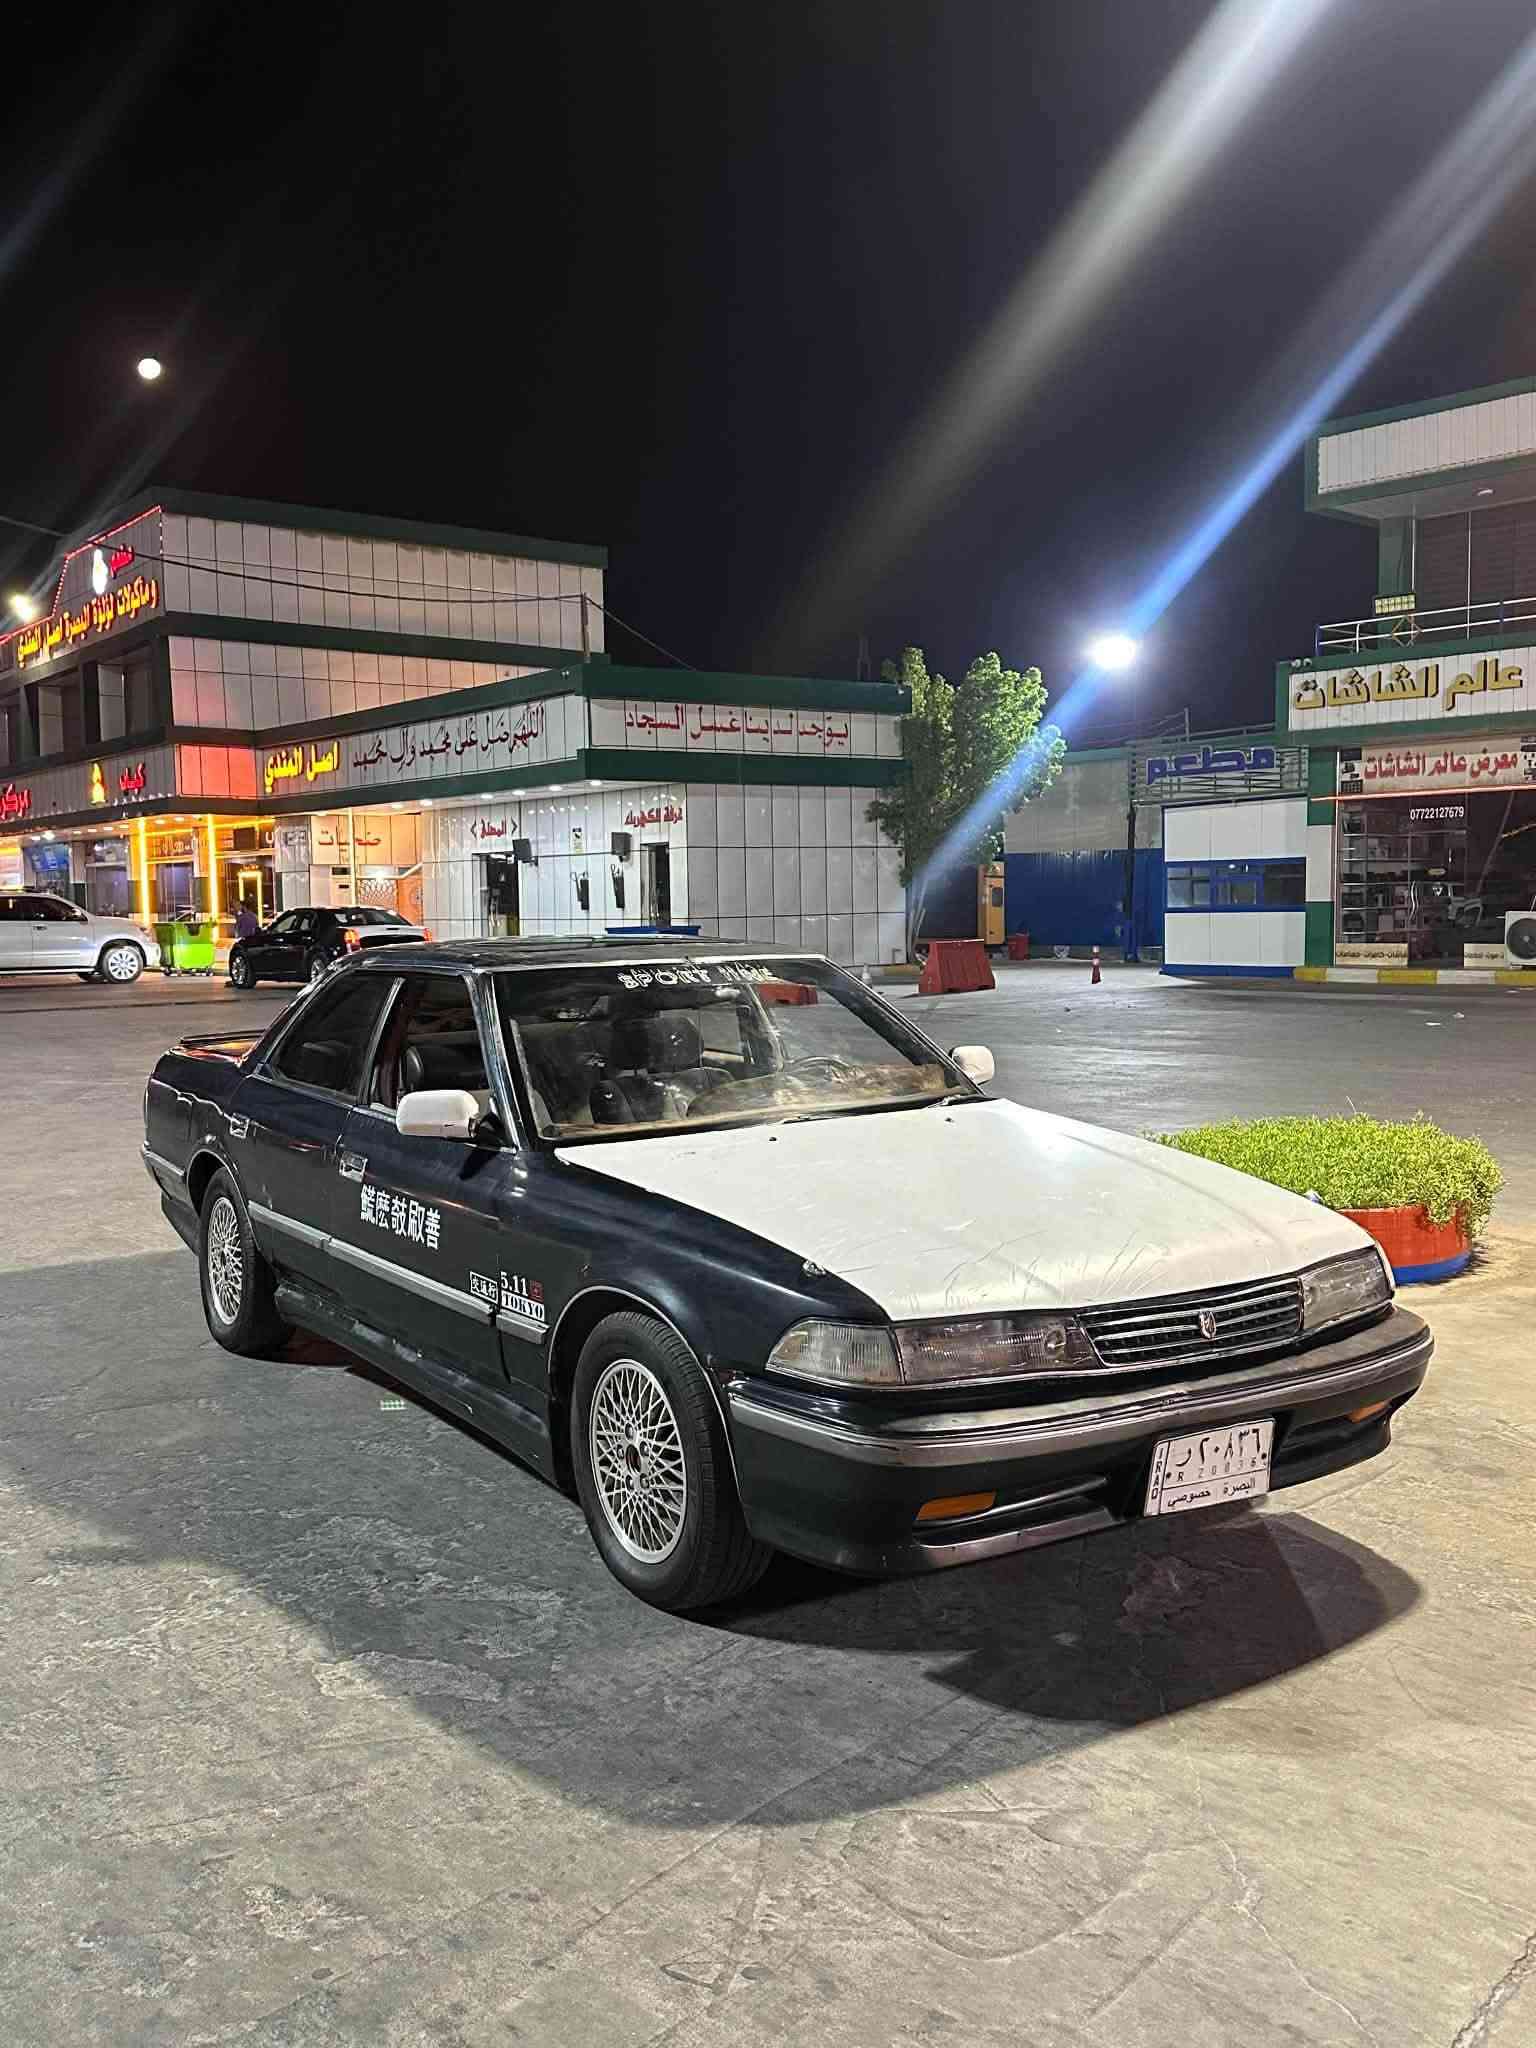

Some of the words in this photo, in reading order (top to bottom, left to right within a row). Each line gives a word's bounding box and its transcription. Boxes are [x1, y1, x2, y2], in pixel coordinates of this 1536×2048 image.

[1295, 663, 1439, 710] الشاشات
[1446, 658, 1523, 711] عالم
[626, 702, 684, 736] السجاد
[690, 705, 741, 741] غسل
[264, 745, 304, 793] المندي
[1145, 744, 1278, 786] مطعم
[1364, 750, 1426, 780] الشاشات
[1427, 750, 1468, 777] عالم
[1470, 747, 1519, 779] معرض
[1409, 806, 1465, 821] 07722127679
[501, 1271, 528, 1296] 5.11
[502, 1293, 544, 1320] TOKYO
[1199, 1427, 1261, 1464] ٢٠٨٣٦
[1177, 1471, 1185, 1482] R
[1223, 1477, 1256, 1497] البصرة
[1168, 1489, 1211, 1511] خصوصي
